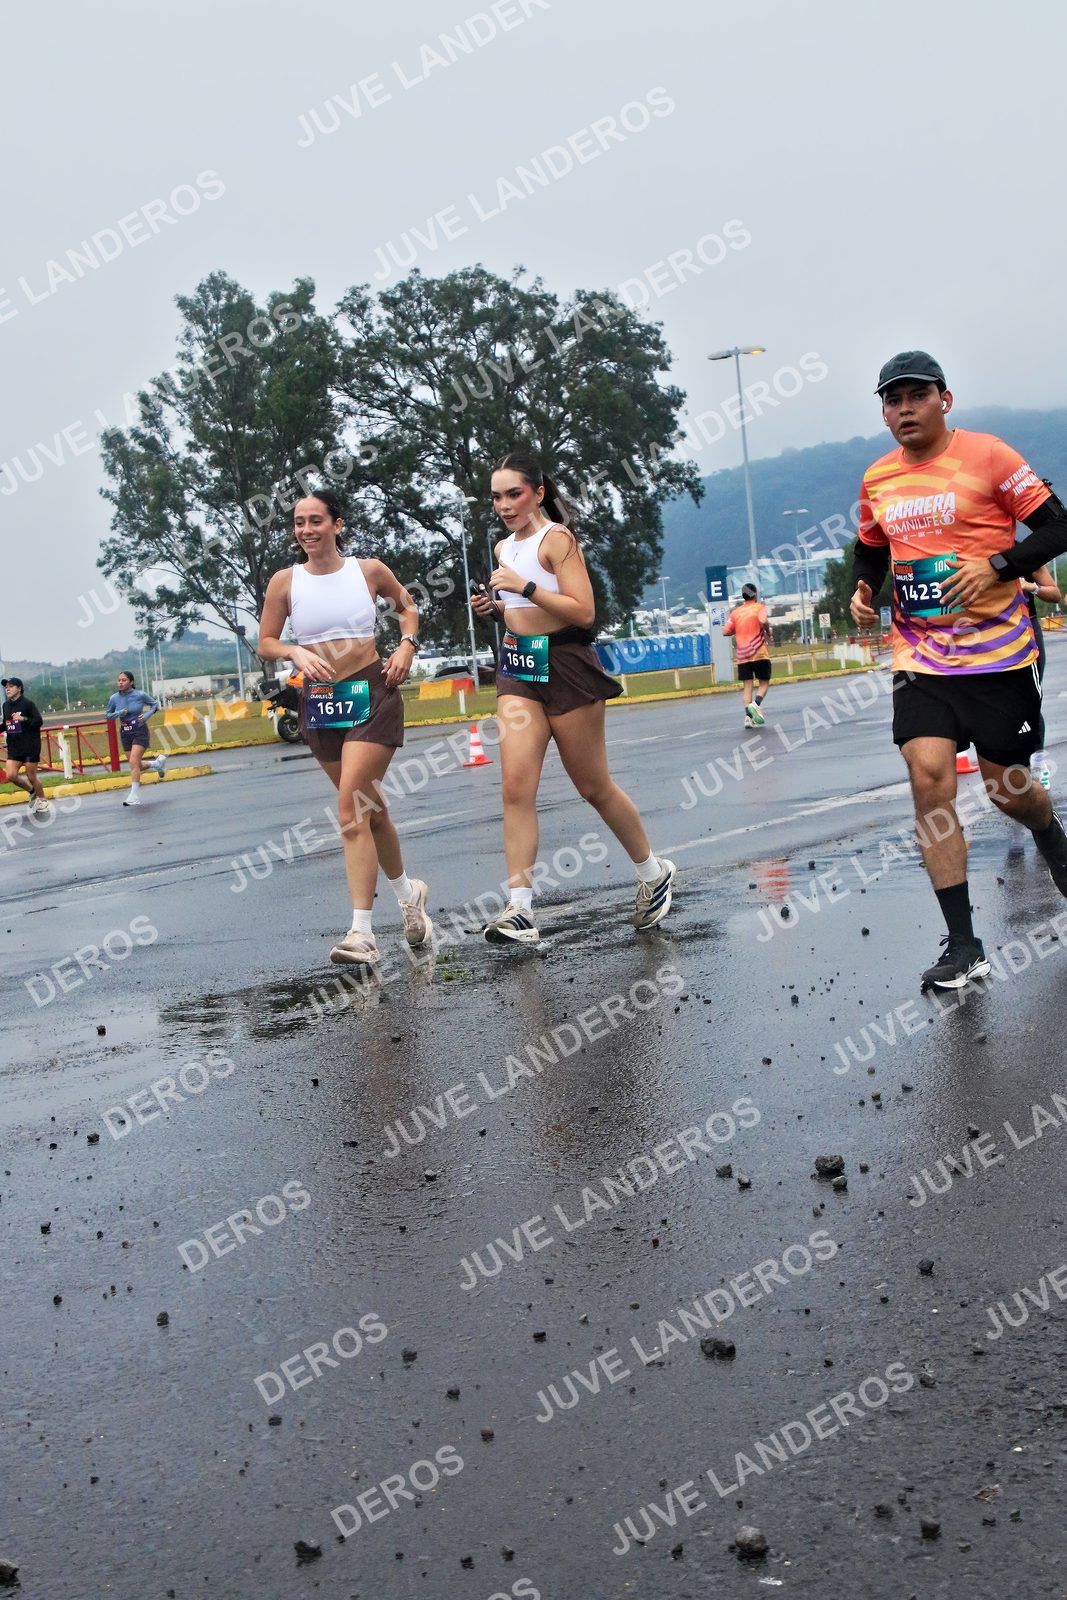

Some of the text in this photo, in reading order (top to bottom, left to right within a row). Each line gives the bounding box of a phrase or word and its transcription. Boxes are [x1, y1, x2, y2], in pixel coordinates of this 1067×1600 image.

[885, 491, 956, 523] CARRERA
[886, 515, 940, 536] OMNILIFE
[710, 581, 722, 597] E
[901, 582, 942, 601] 1423
[531, 639, 544, 649] 10K
[507, 652, 535, 669] 1616
[351, 684, 364, 694] 10K
[317, 700, 354, 715] 1617
